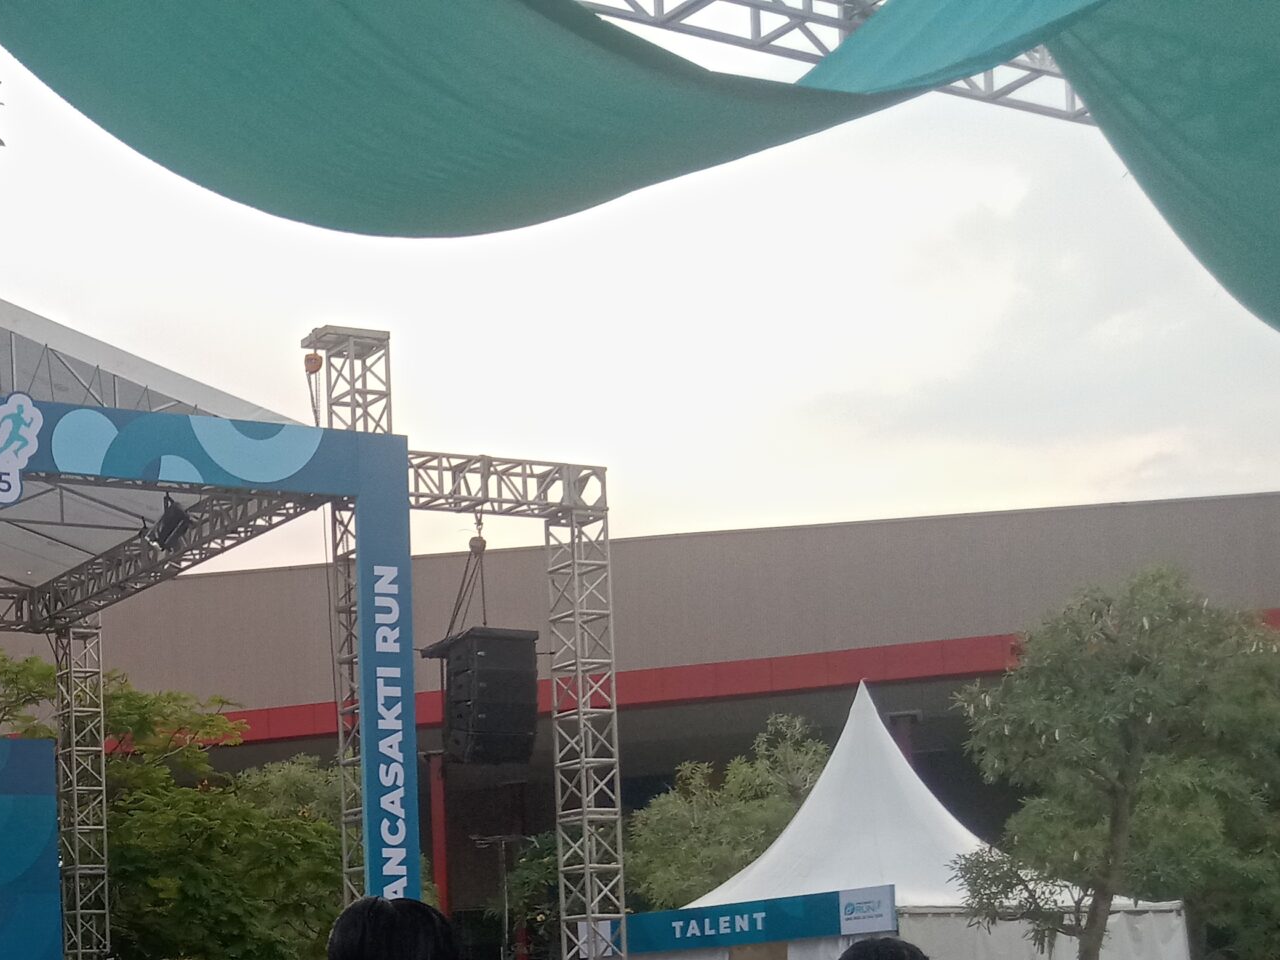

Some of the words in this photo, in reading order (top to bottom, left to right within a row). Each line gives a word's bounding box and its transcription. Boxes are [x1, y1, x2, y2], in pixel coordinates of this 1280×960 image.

[373, 565, 400, 653] RUN
[376, 666, 408, 900] ANCASAKTI
[671, 912, 767, 939] TALENT
